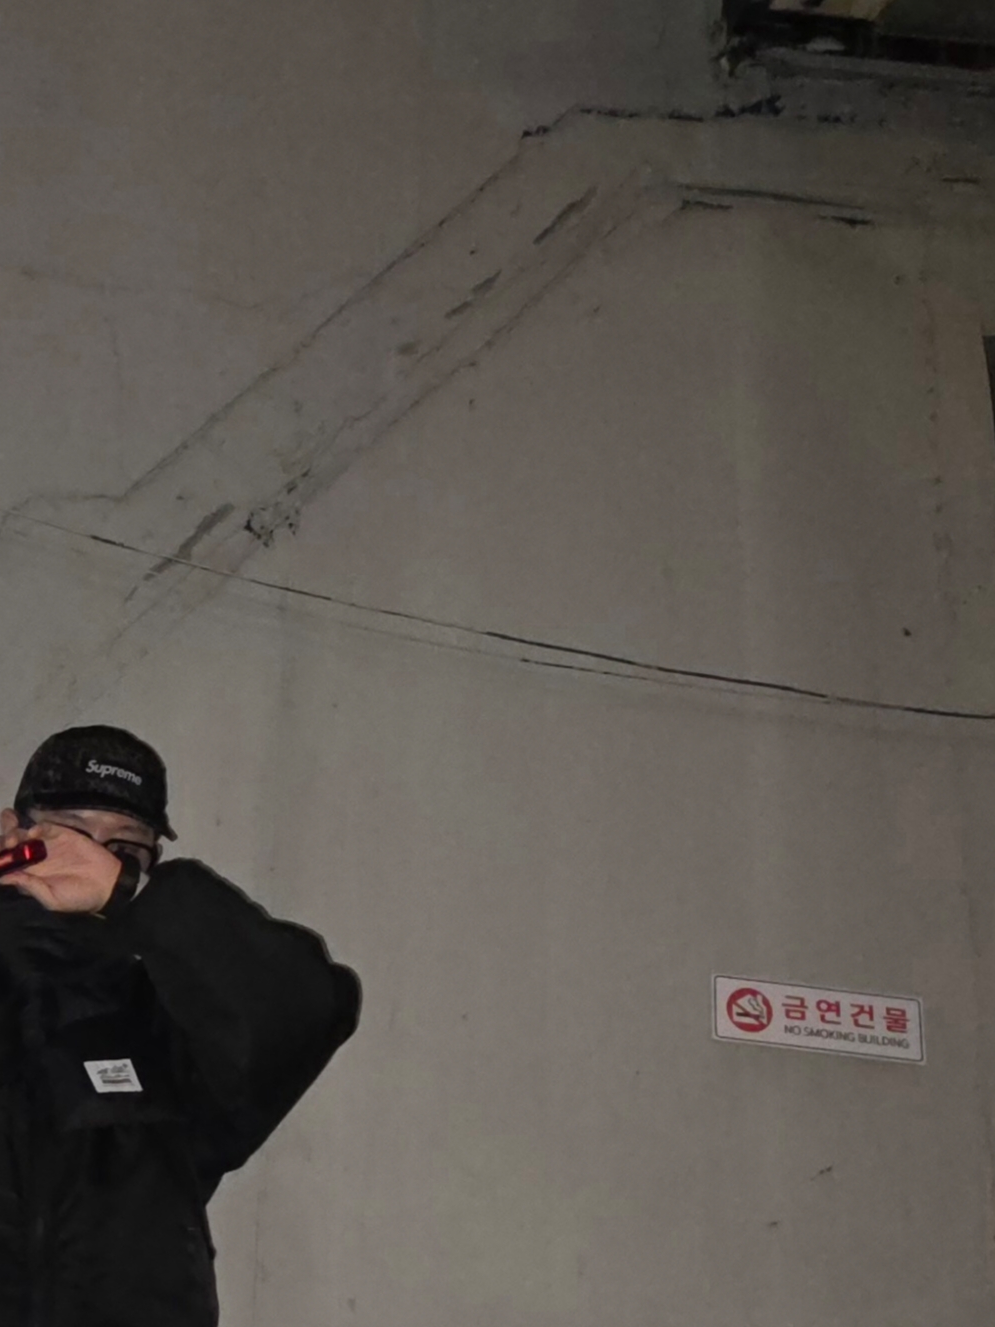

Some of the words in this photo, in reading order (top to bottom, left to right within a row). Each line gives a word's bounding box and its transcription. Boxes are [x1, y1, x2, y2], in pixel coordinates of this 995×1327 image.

[85, 759, 143, 786] Supreme
[781, 994, 911, 1034] 금연건물
[784, 1024, 802, 1036] NO
[803, 1026, 856, 1043] SMOKING
[857, 1033, 910, 1050] BUILDING
